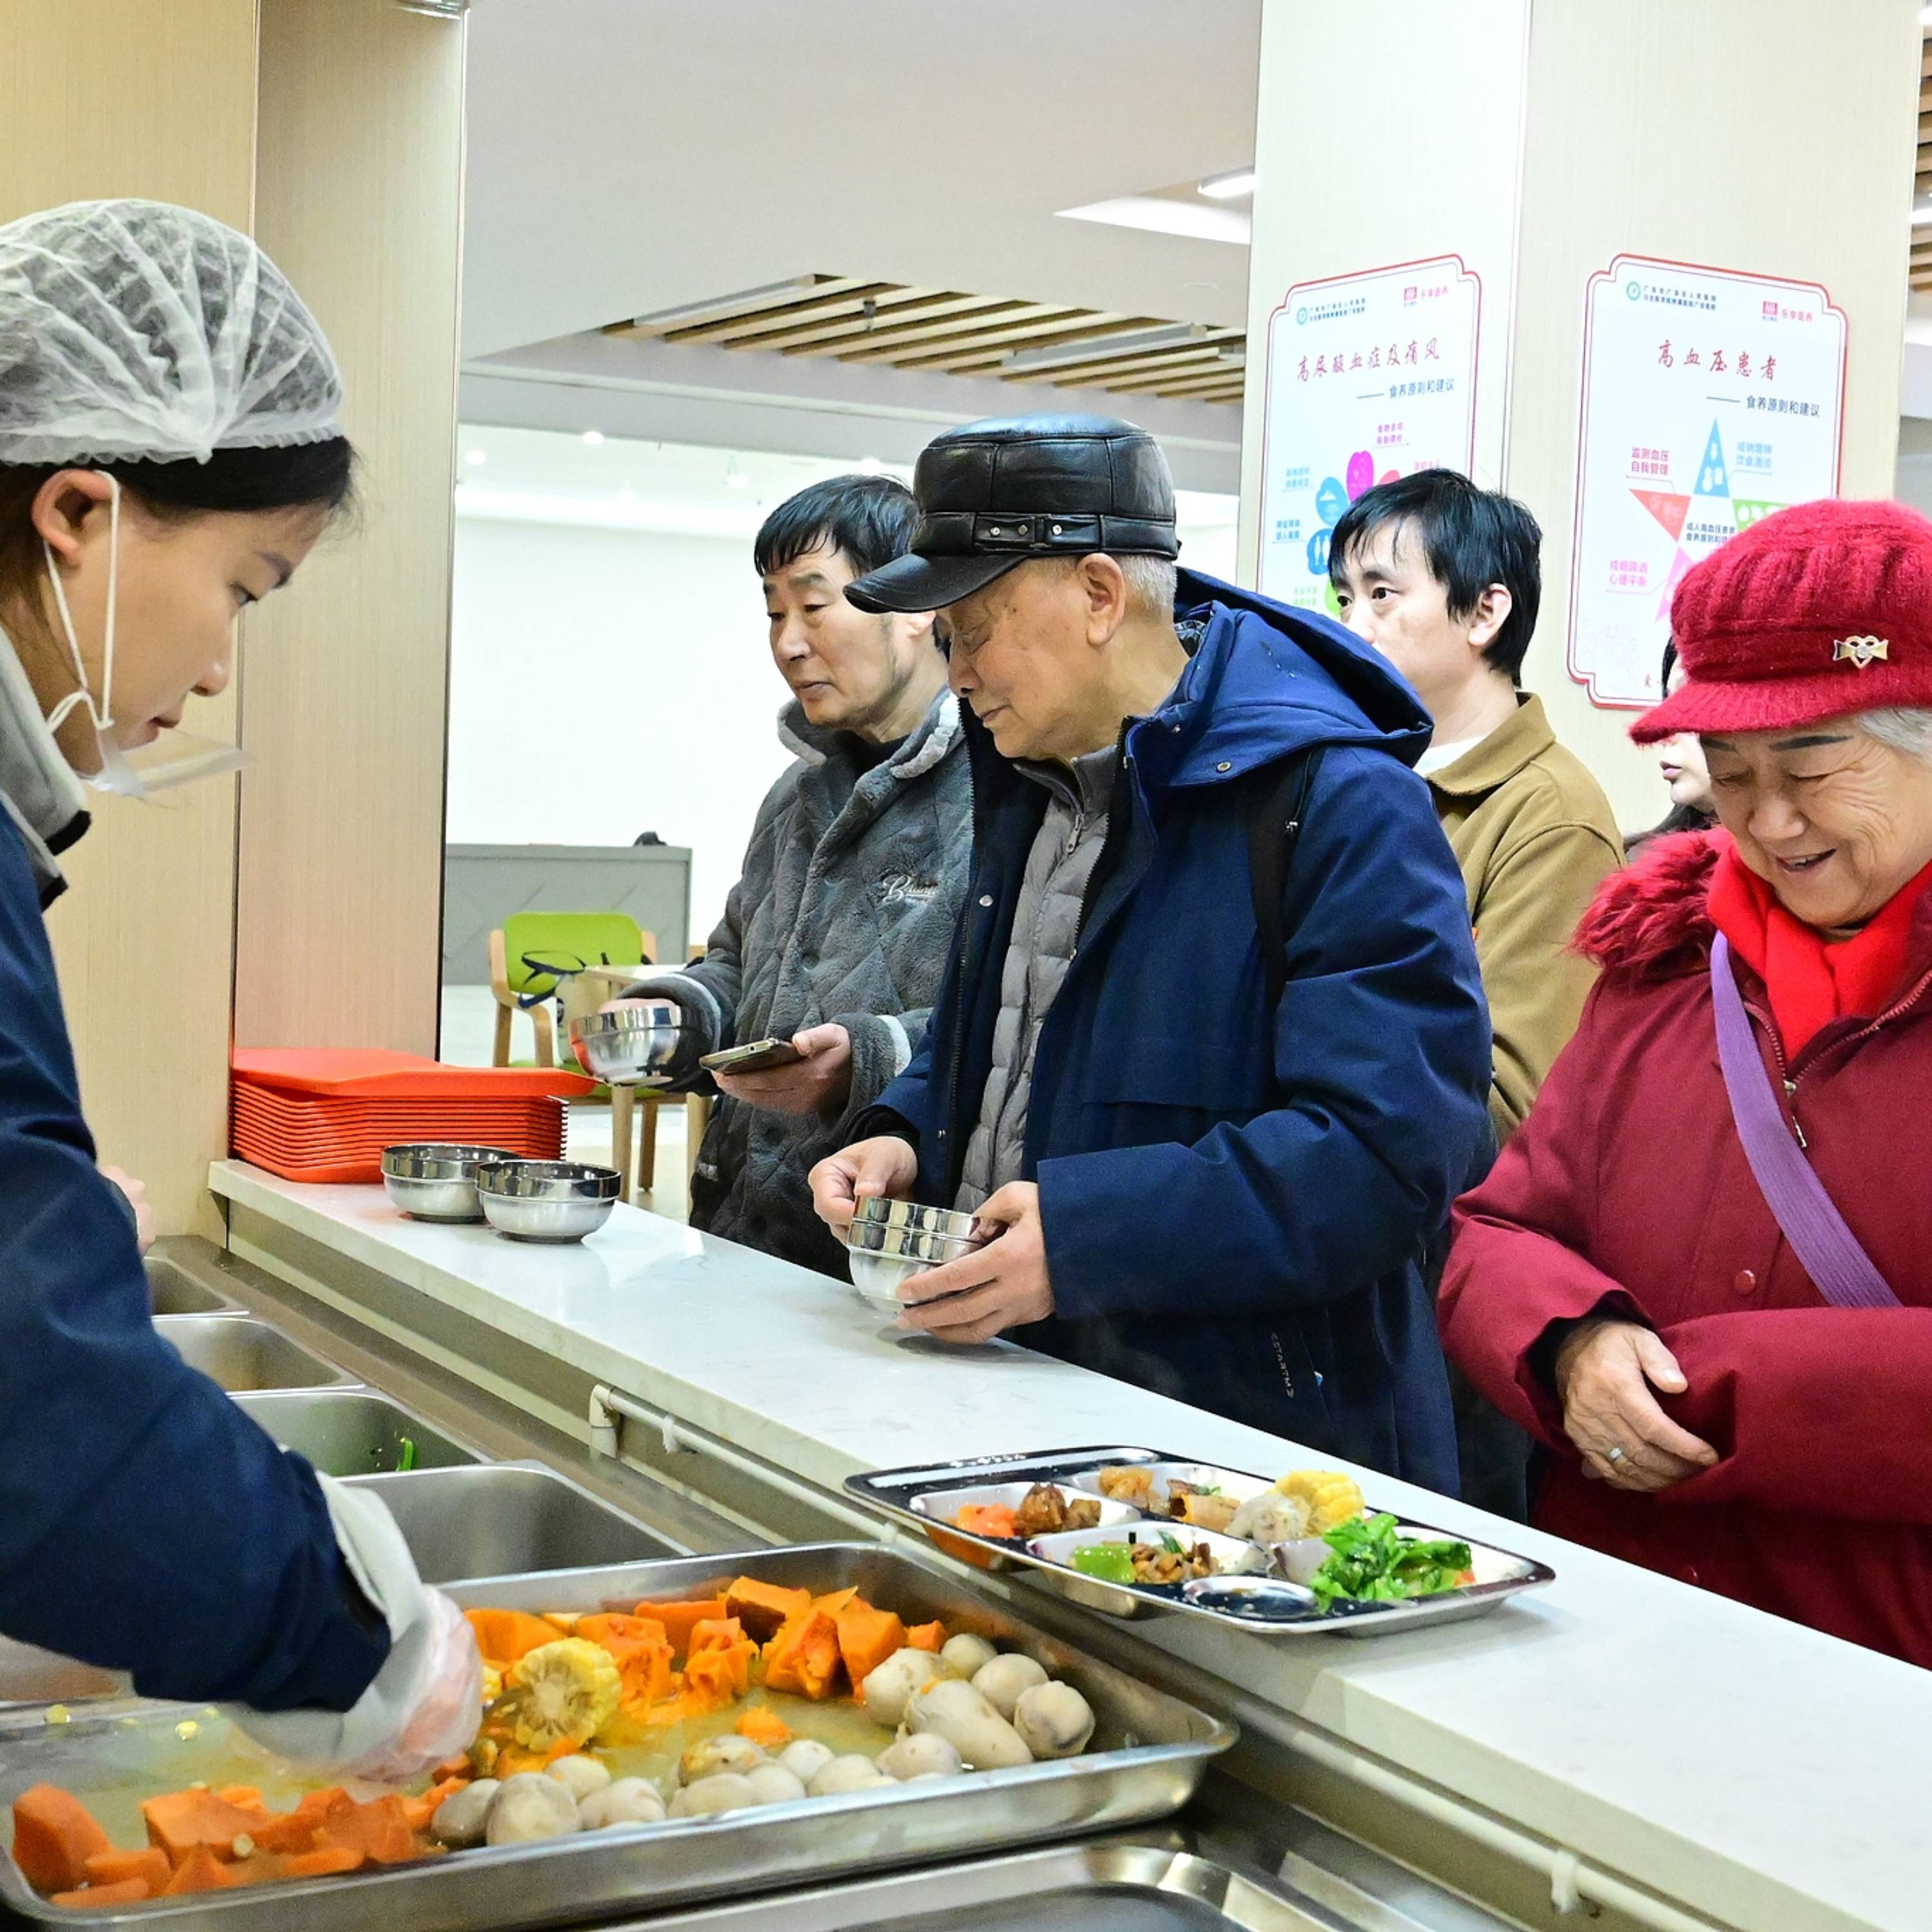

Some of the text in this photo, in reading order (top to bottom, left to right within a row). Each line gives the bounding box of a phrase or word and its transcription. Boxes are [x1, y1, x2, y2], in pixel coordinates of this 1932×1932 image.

[1298, 337, 1439, 381] 高尿酸血症及痛风
[1658, 339, 1777, 381] 高血压患者
[1390, 379, 1454, 399] 食养原则和建议
[1747, 395, 1820, 417] 食养原则和建议
[1632, 447, 1669, 461] 监测血压
[1631, 461, 1669, 475] 自我管理
